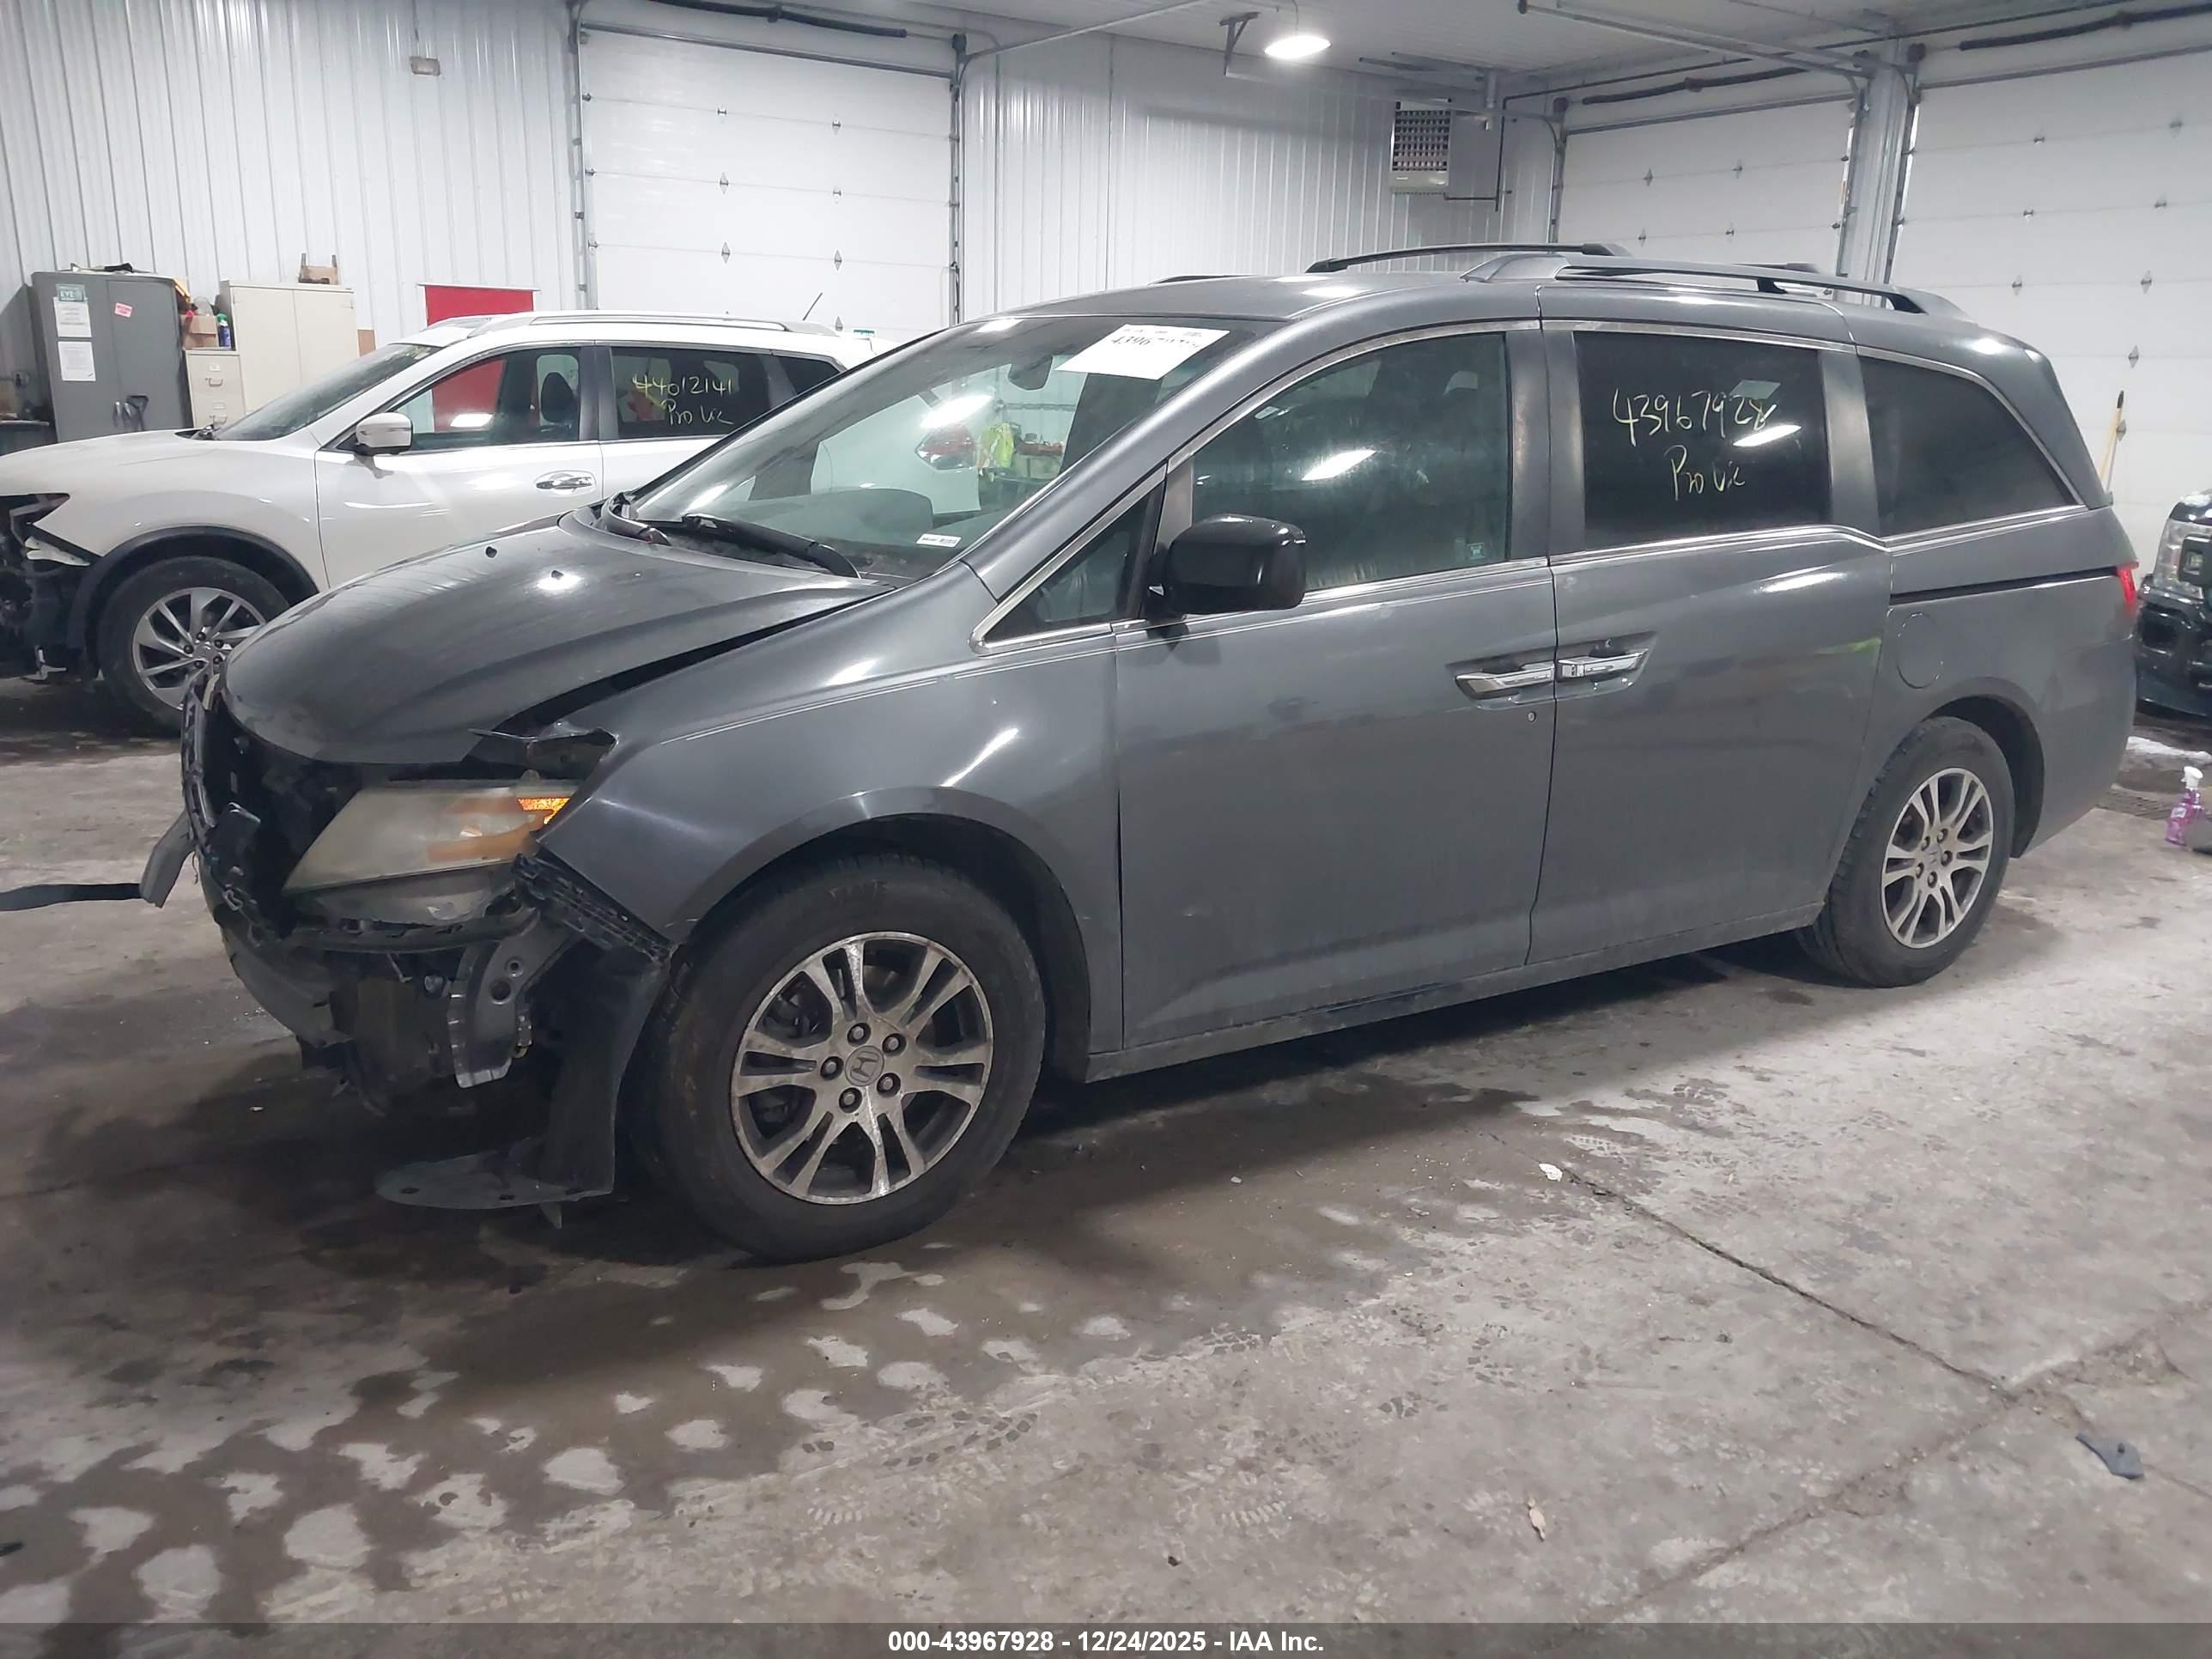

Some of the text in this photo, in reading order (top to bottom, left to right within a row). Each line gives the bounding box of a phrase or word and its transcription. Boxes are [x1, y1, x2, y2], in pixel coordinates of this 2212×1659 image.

[632, 374, 732, 397] 44012141
[660, 398, 693, 425] Pro
[1613, 388, 1774, 447] 43967928
[1663, 445, 1705, 501] Pro
